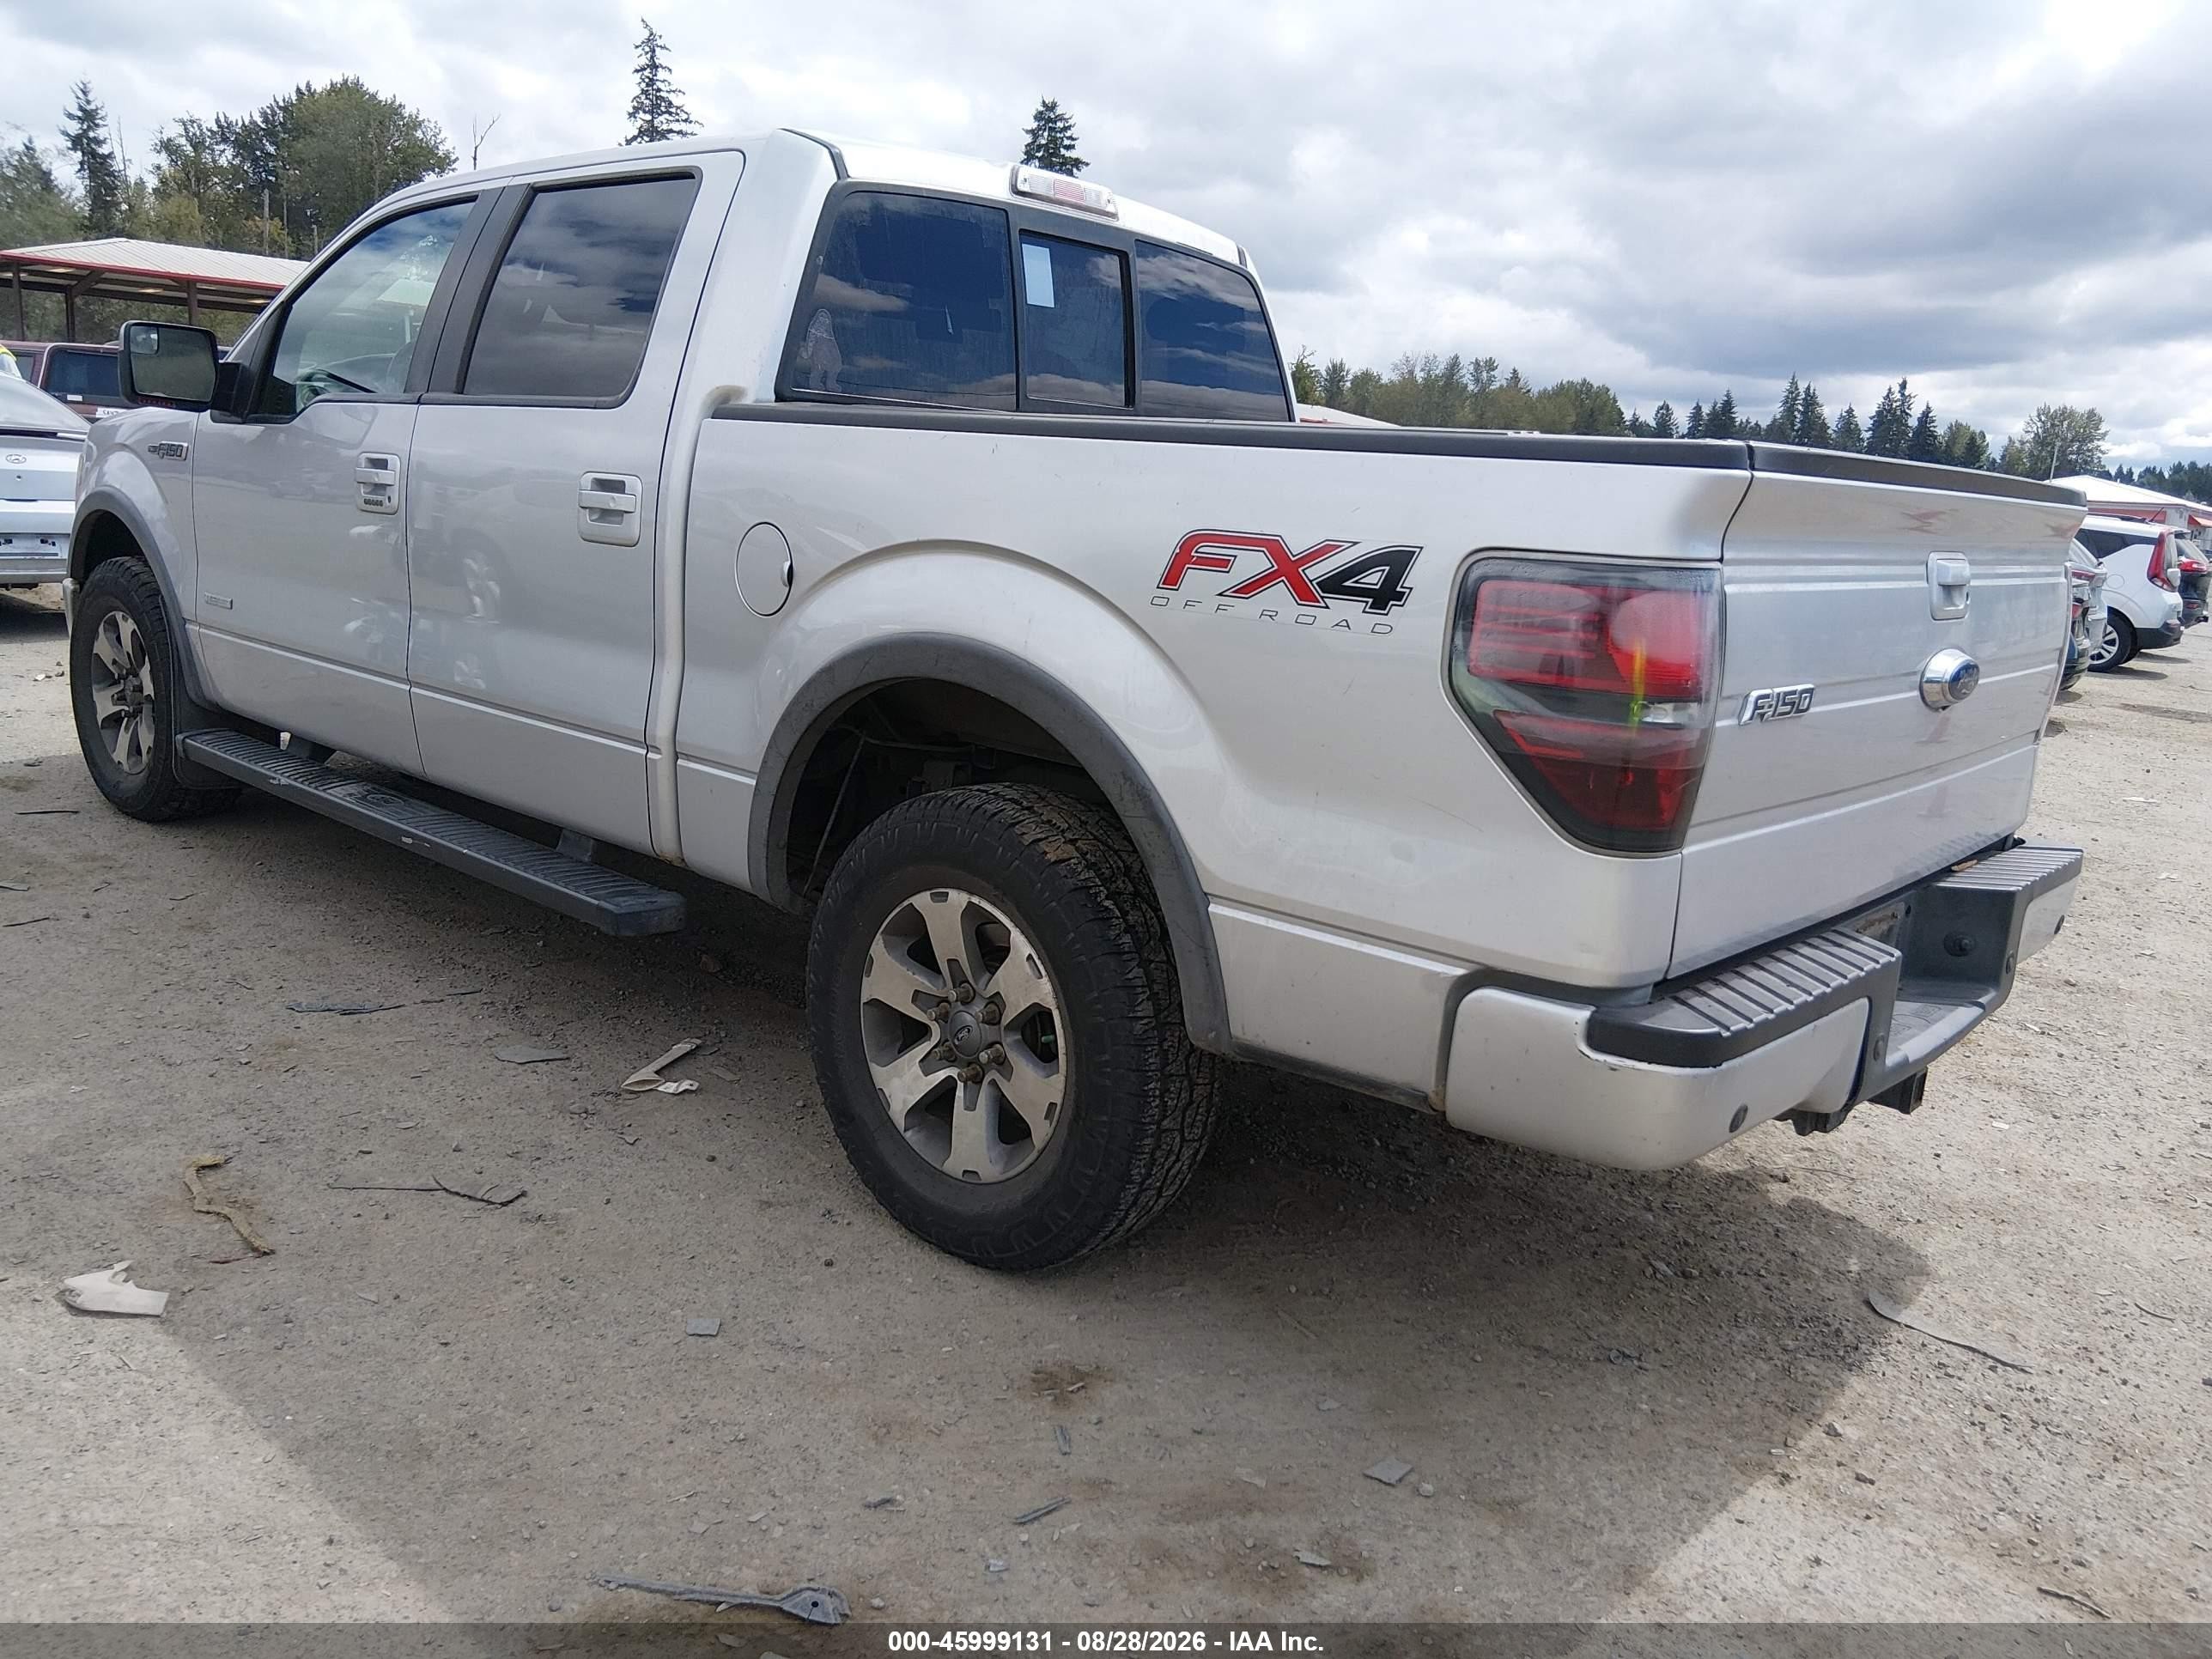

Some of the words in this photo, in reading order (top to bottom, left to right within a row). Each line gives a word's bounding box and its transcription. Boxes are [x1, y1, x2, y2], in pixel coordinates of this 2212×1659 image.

[1157, 528, 1424, 616] FX4
[1149, 595, 1235, 615] OFF
[1258, 609, 1394, 635] ROAD
